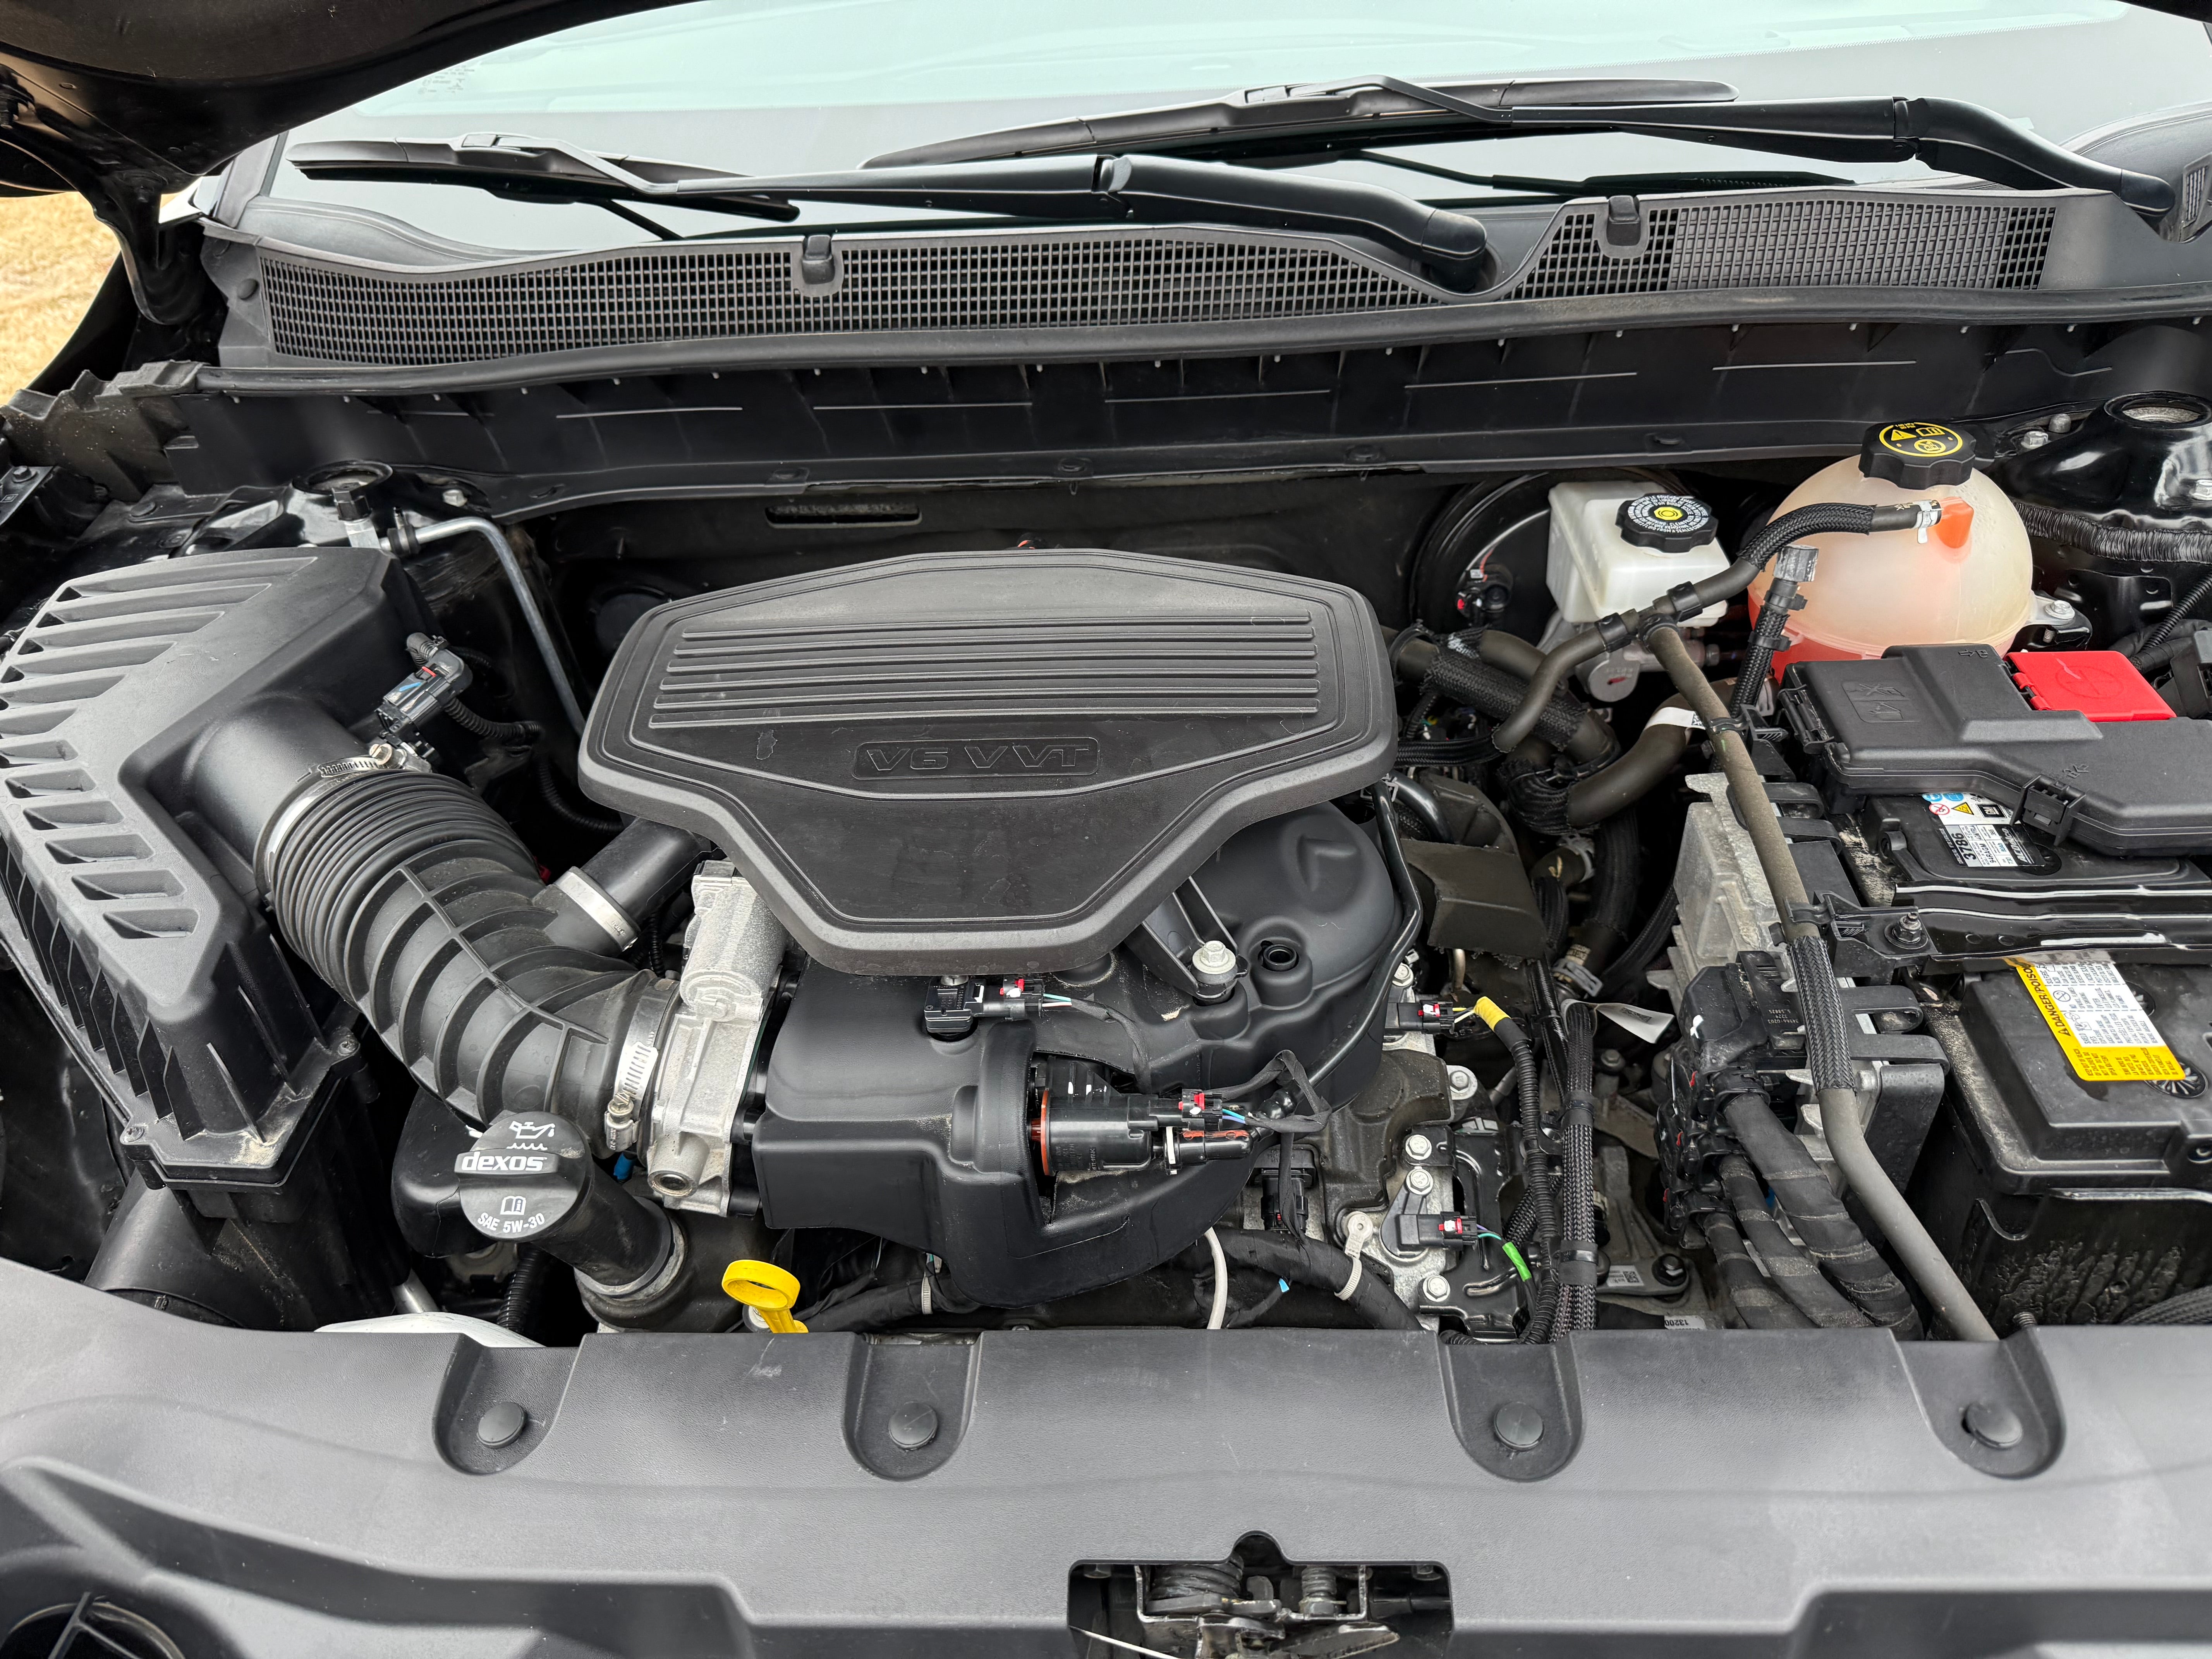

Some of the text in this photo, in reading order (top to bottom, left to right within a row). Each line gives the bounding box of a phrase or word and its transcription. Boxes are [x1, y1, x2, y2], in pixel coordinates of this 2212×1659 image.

[866, 745, 1089, 771] V6 VVT
[1952, 833, 1975, 859] 3786
[2001, 828, 2028, 863] ACDelco
[2079, 1033, 2091, 1043] SHIELD
[462, 1151, 544, 1171] dexos
[478, 1212, 545, 1233] SAE 5W-30
